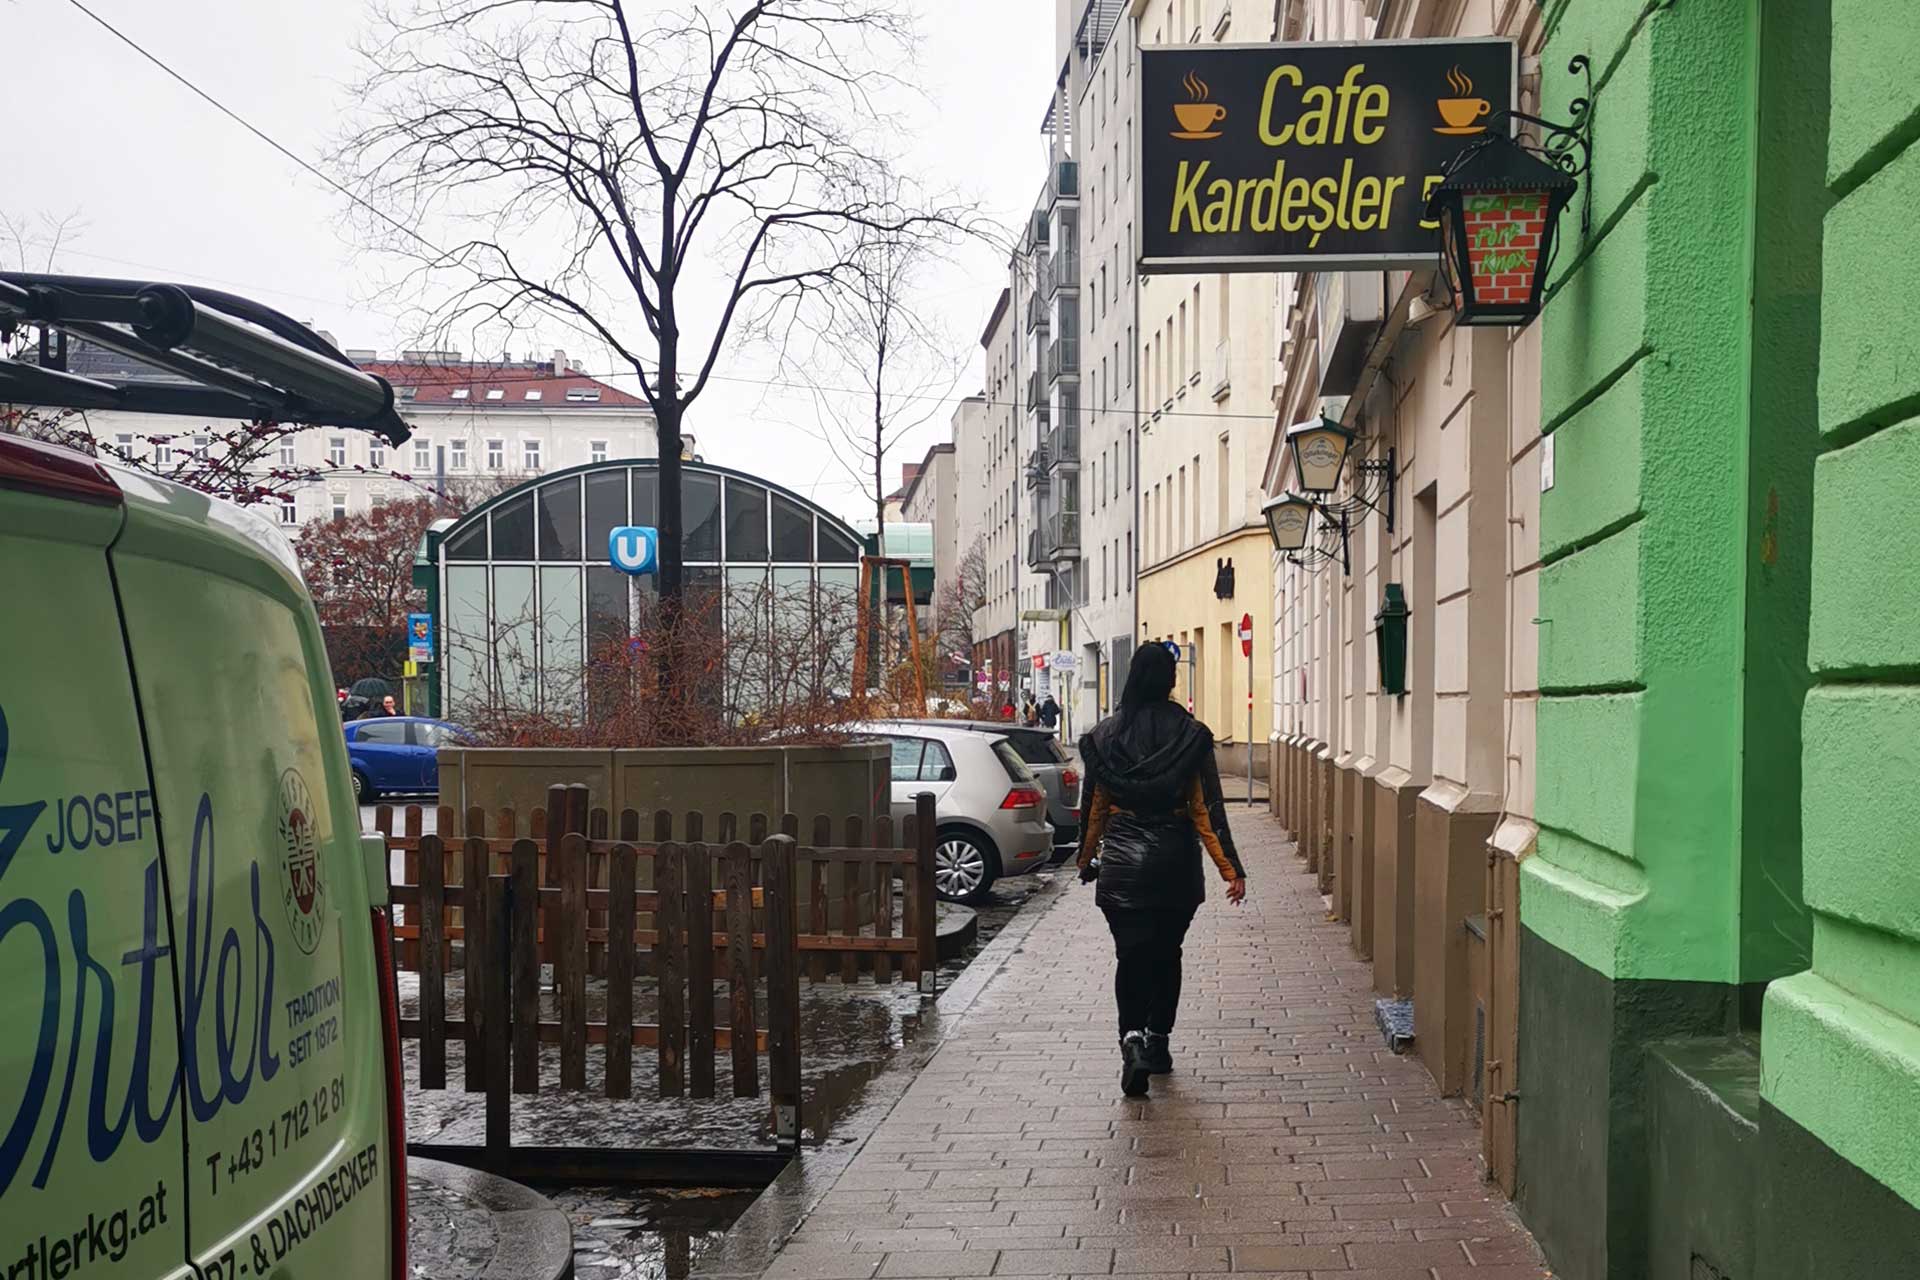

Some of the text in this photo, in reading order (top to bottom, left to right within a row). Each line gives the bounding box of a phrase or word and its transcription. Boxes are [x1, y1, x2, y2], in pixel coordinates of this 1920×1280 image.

[1257, 64, 1390, 146] Cafe
[1169, 159, 1406, 248] Kardeşler
[617, 536, 647, 567] U
[47, 789, 152, 855] JOSEF
[286, 975, 340, 1029] TRADITION
[288, 1015, 339, 1069] SEIT 1872
[207, 1073, 345, 1196] T +43 1 712 12 81
[250, 1233, 271, 1277] &
[267, 1143, 378, 1261] DACHDECKER
